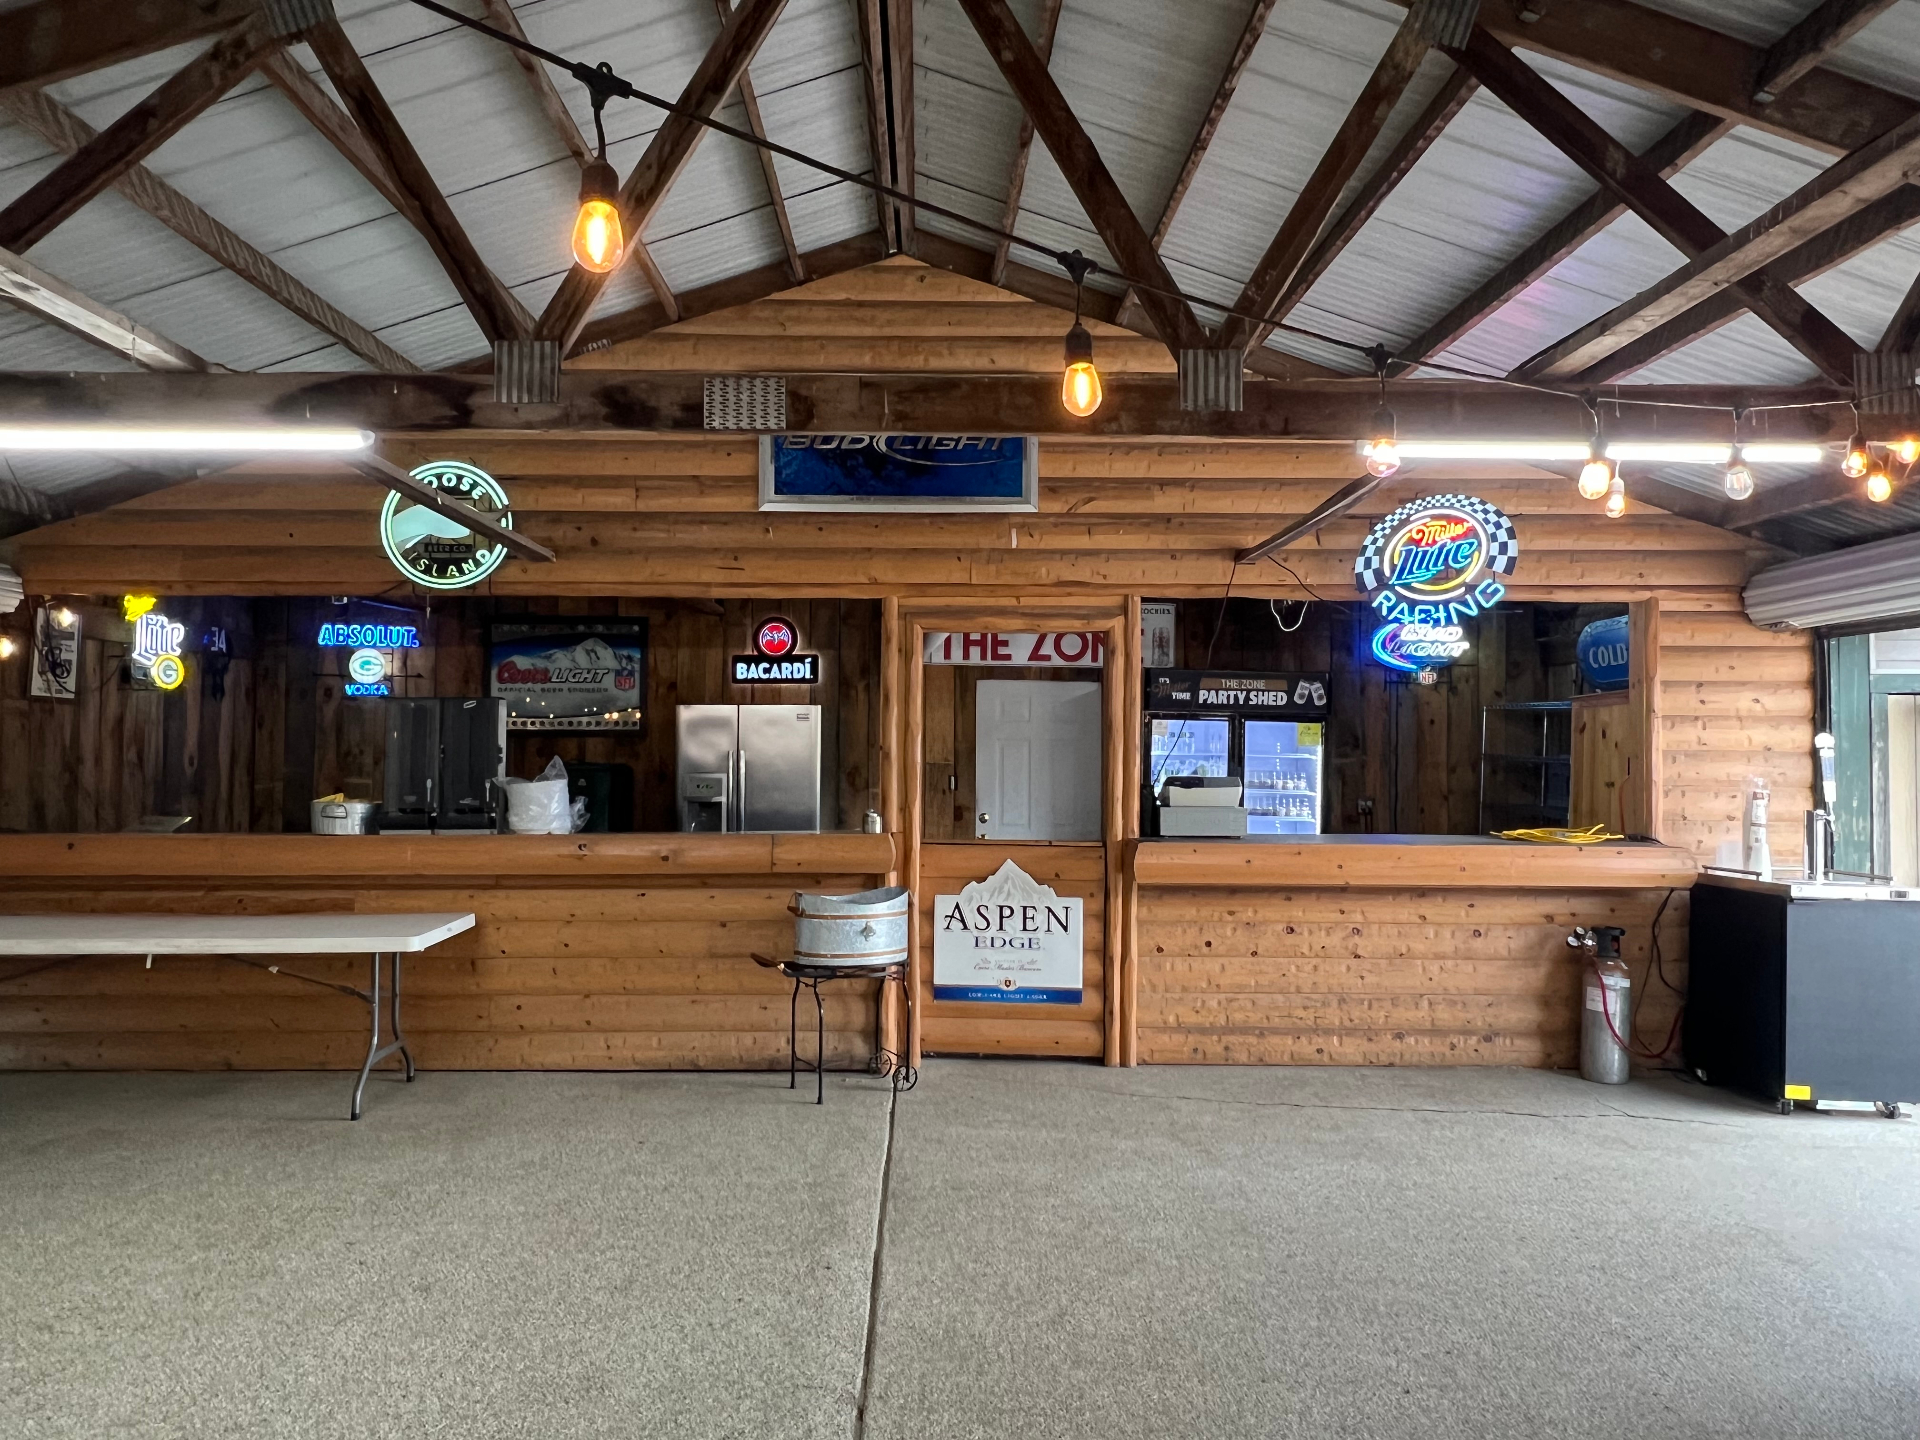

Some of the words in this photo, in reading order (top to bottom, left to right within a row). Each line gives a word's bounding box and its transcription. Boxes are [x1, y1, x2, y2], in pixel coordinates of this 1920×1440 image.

[783, 434, 870, 450] BUD
[892, 435, 1001, 451] LIGHT
[423, 473, 487, 500] OOSE
[1411, 521, 1473, 546] Miller
[407, 549, 491, 577] ISLAND
[1388, 538, 1479, 585] Lite
[1371, 578, 1506, 626] RACING
[131, 613, 185, 665] Lite
[943, 632, 1013, 662] THE
[1588, 643, 1628, 669] COLD
[549, 667, 610, 684] LIGHT
[1220, 678, 1239, 690] THE
[1240, 679, 1267, 690] ZONE
[1421, 672, 1437, 684] NFL
[345, 684, 389, 696] VODKA
[1171, 691, 1192, 700] TIME
[1198, 690, 1246, 705] PARTY
[1249, 691, 1288, 706] SHED
[943, 901, 1073, 935] ASPEN
[973, 936, 1042, 950] EDGE
